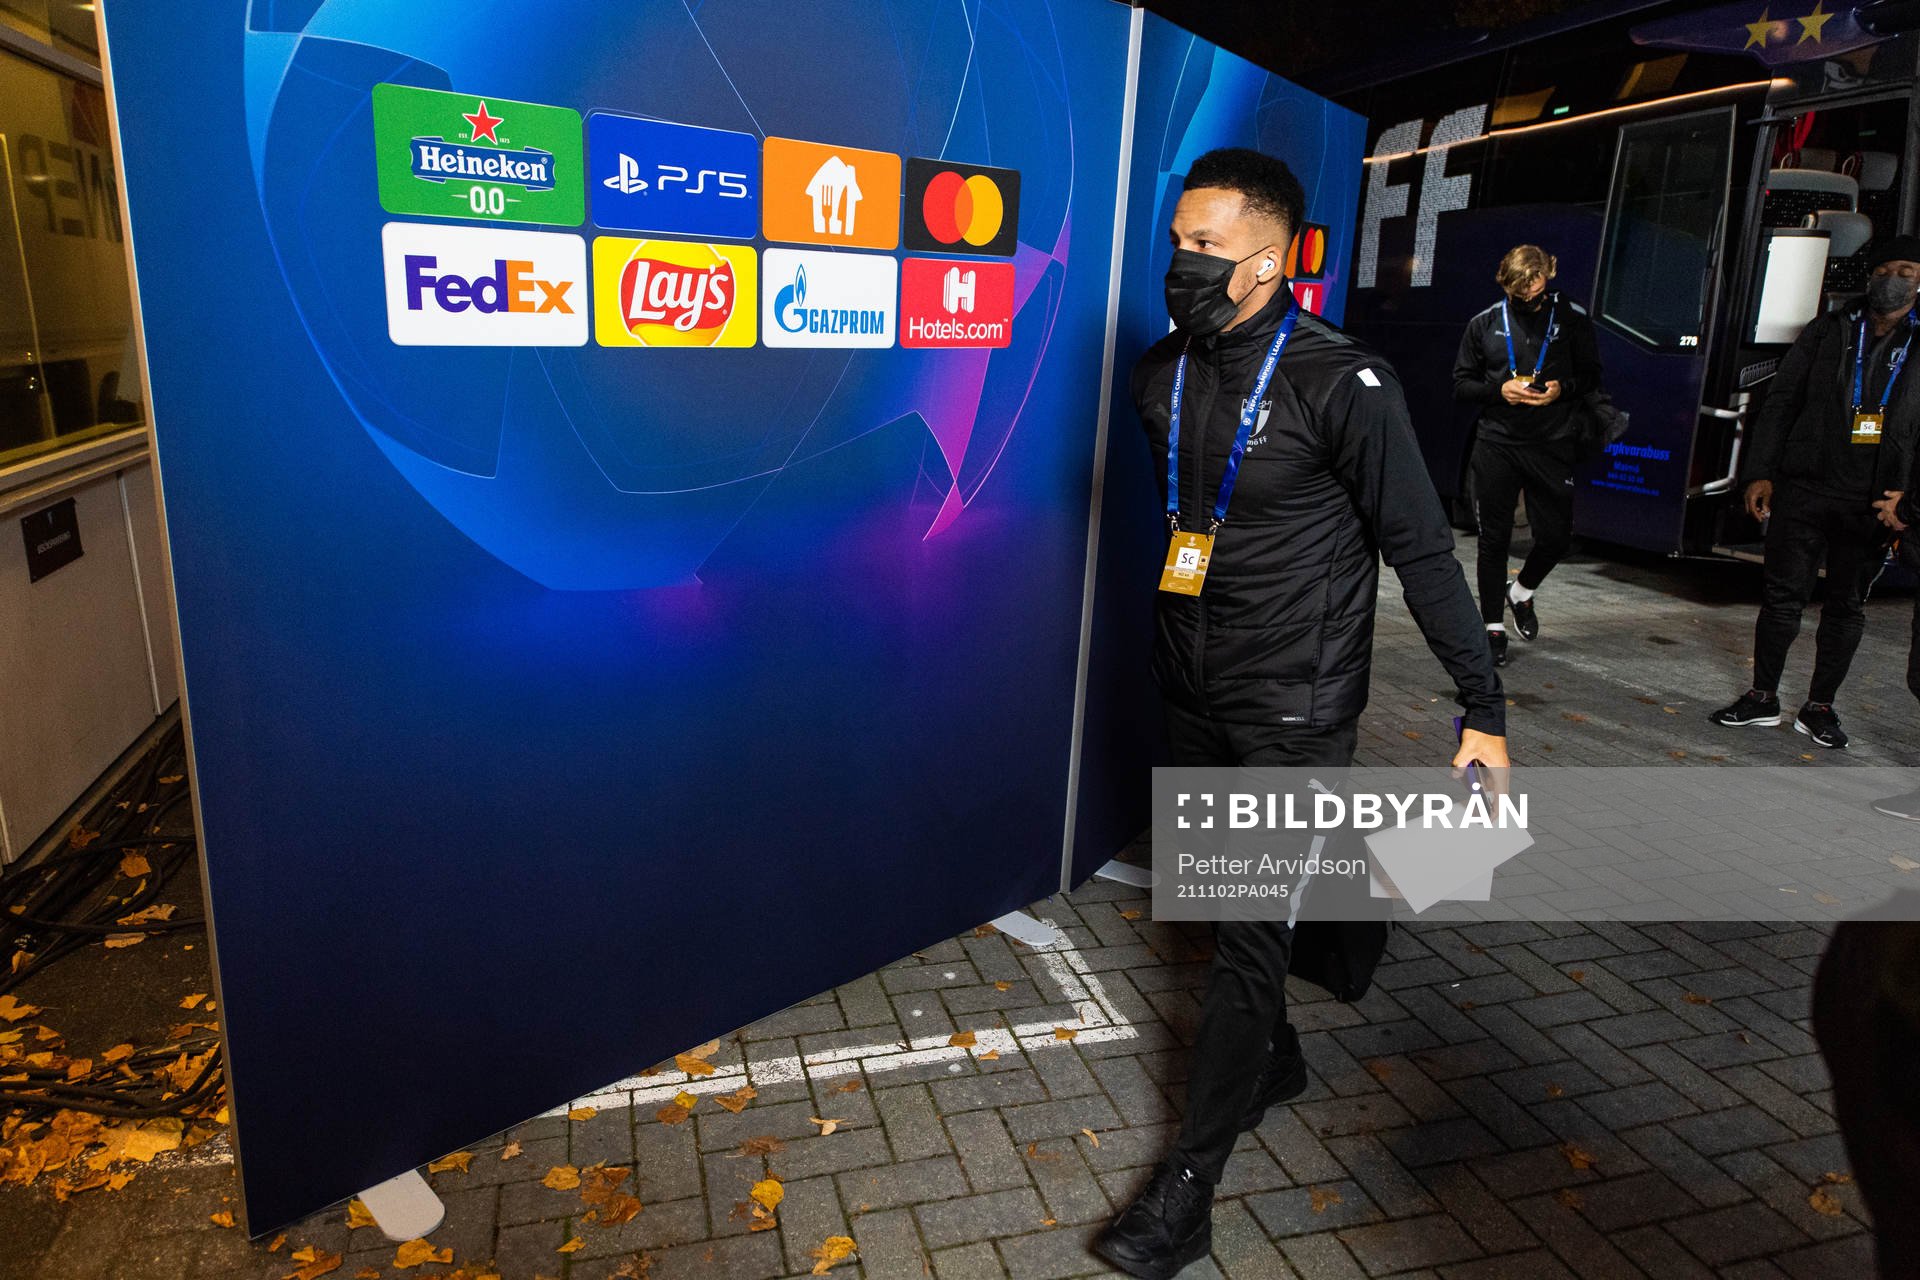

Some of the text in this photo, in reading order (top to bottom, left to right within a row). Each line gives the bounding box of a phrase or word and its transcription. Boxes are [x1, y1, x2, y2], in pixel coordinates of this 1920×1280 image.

[418, 145, 548, 182] Heineken
[657, 164, 748, 199] PS5
[469, 186, 505, 215] 0.0
[404, 254, 575, 314] FedEx
[628, 264, 729, 332] Lay's
[808, 308, 885, 335] GAZPROM
[909, 316, 1003, 340] Hotels.com
[1248, 332, 1287, 413] UEFA CHAMPIONS LEAGUE
[1604, 441, 1671, 461] rgkvarabuss
